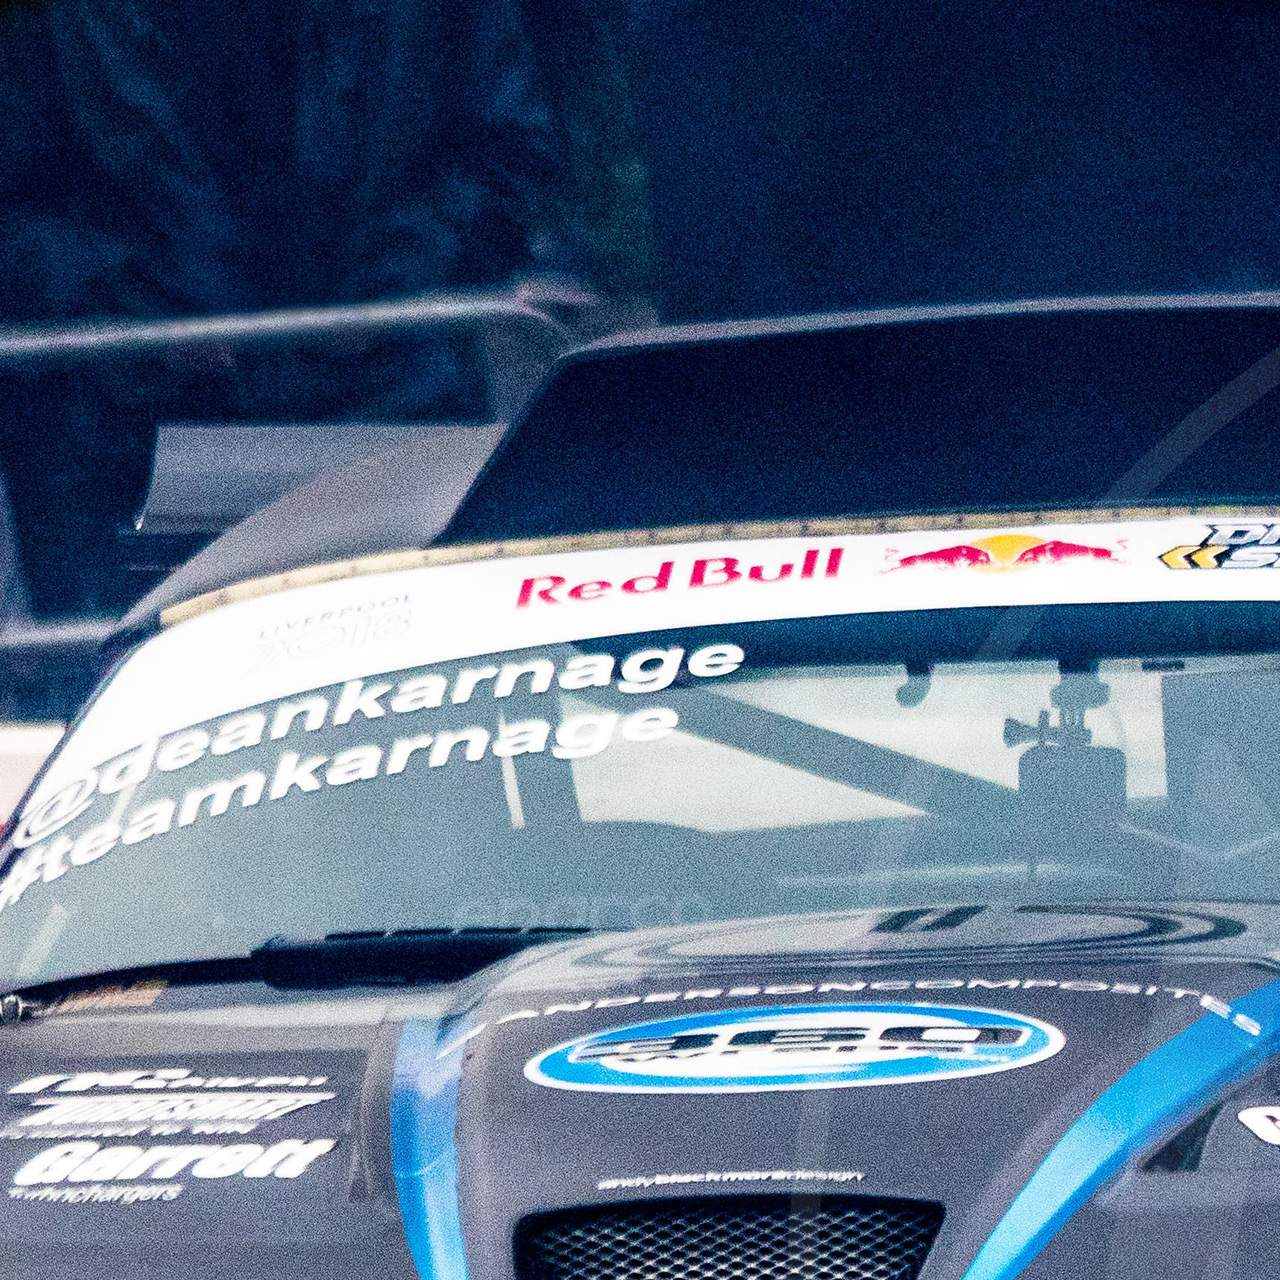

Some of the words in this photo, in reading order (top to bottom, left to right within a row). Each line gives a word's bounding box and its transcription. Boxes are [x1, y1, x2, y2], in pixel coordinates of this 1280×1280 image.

[515, 560, 675, 609] Red
[687, 546, 844, 589] Bull
[10, 643, 746, 850] @deankarnage
[12, 1137, 338, 1187] Garrett
